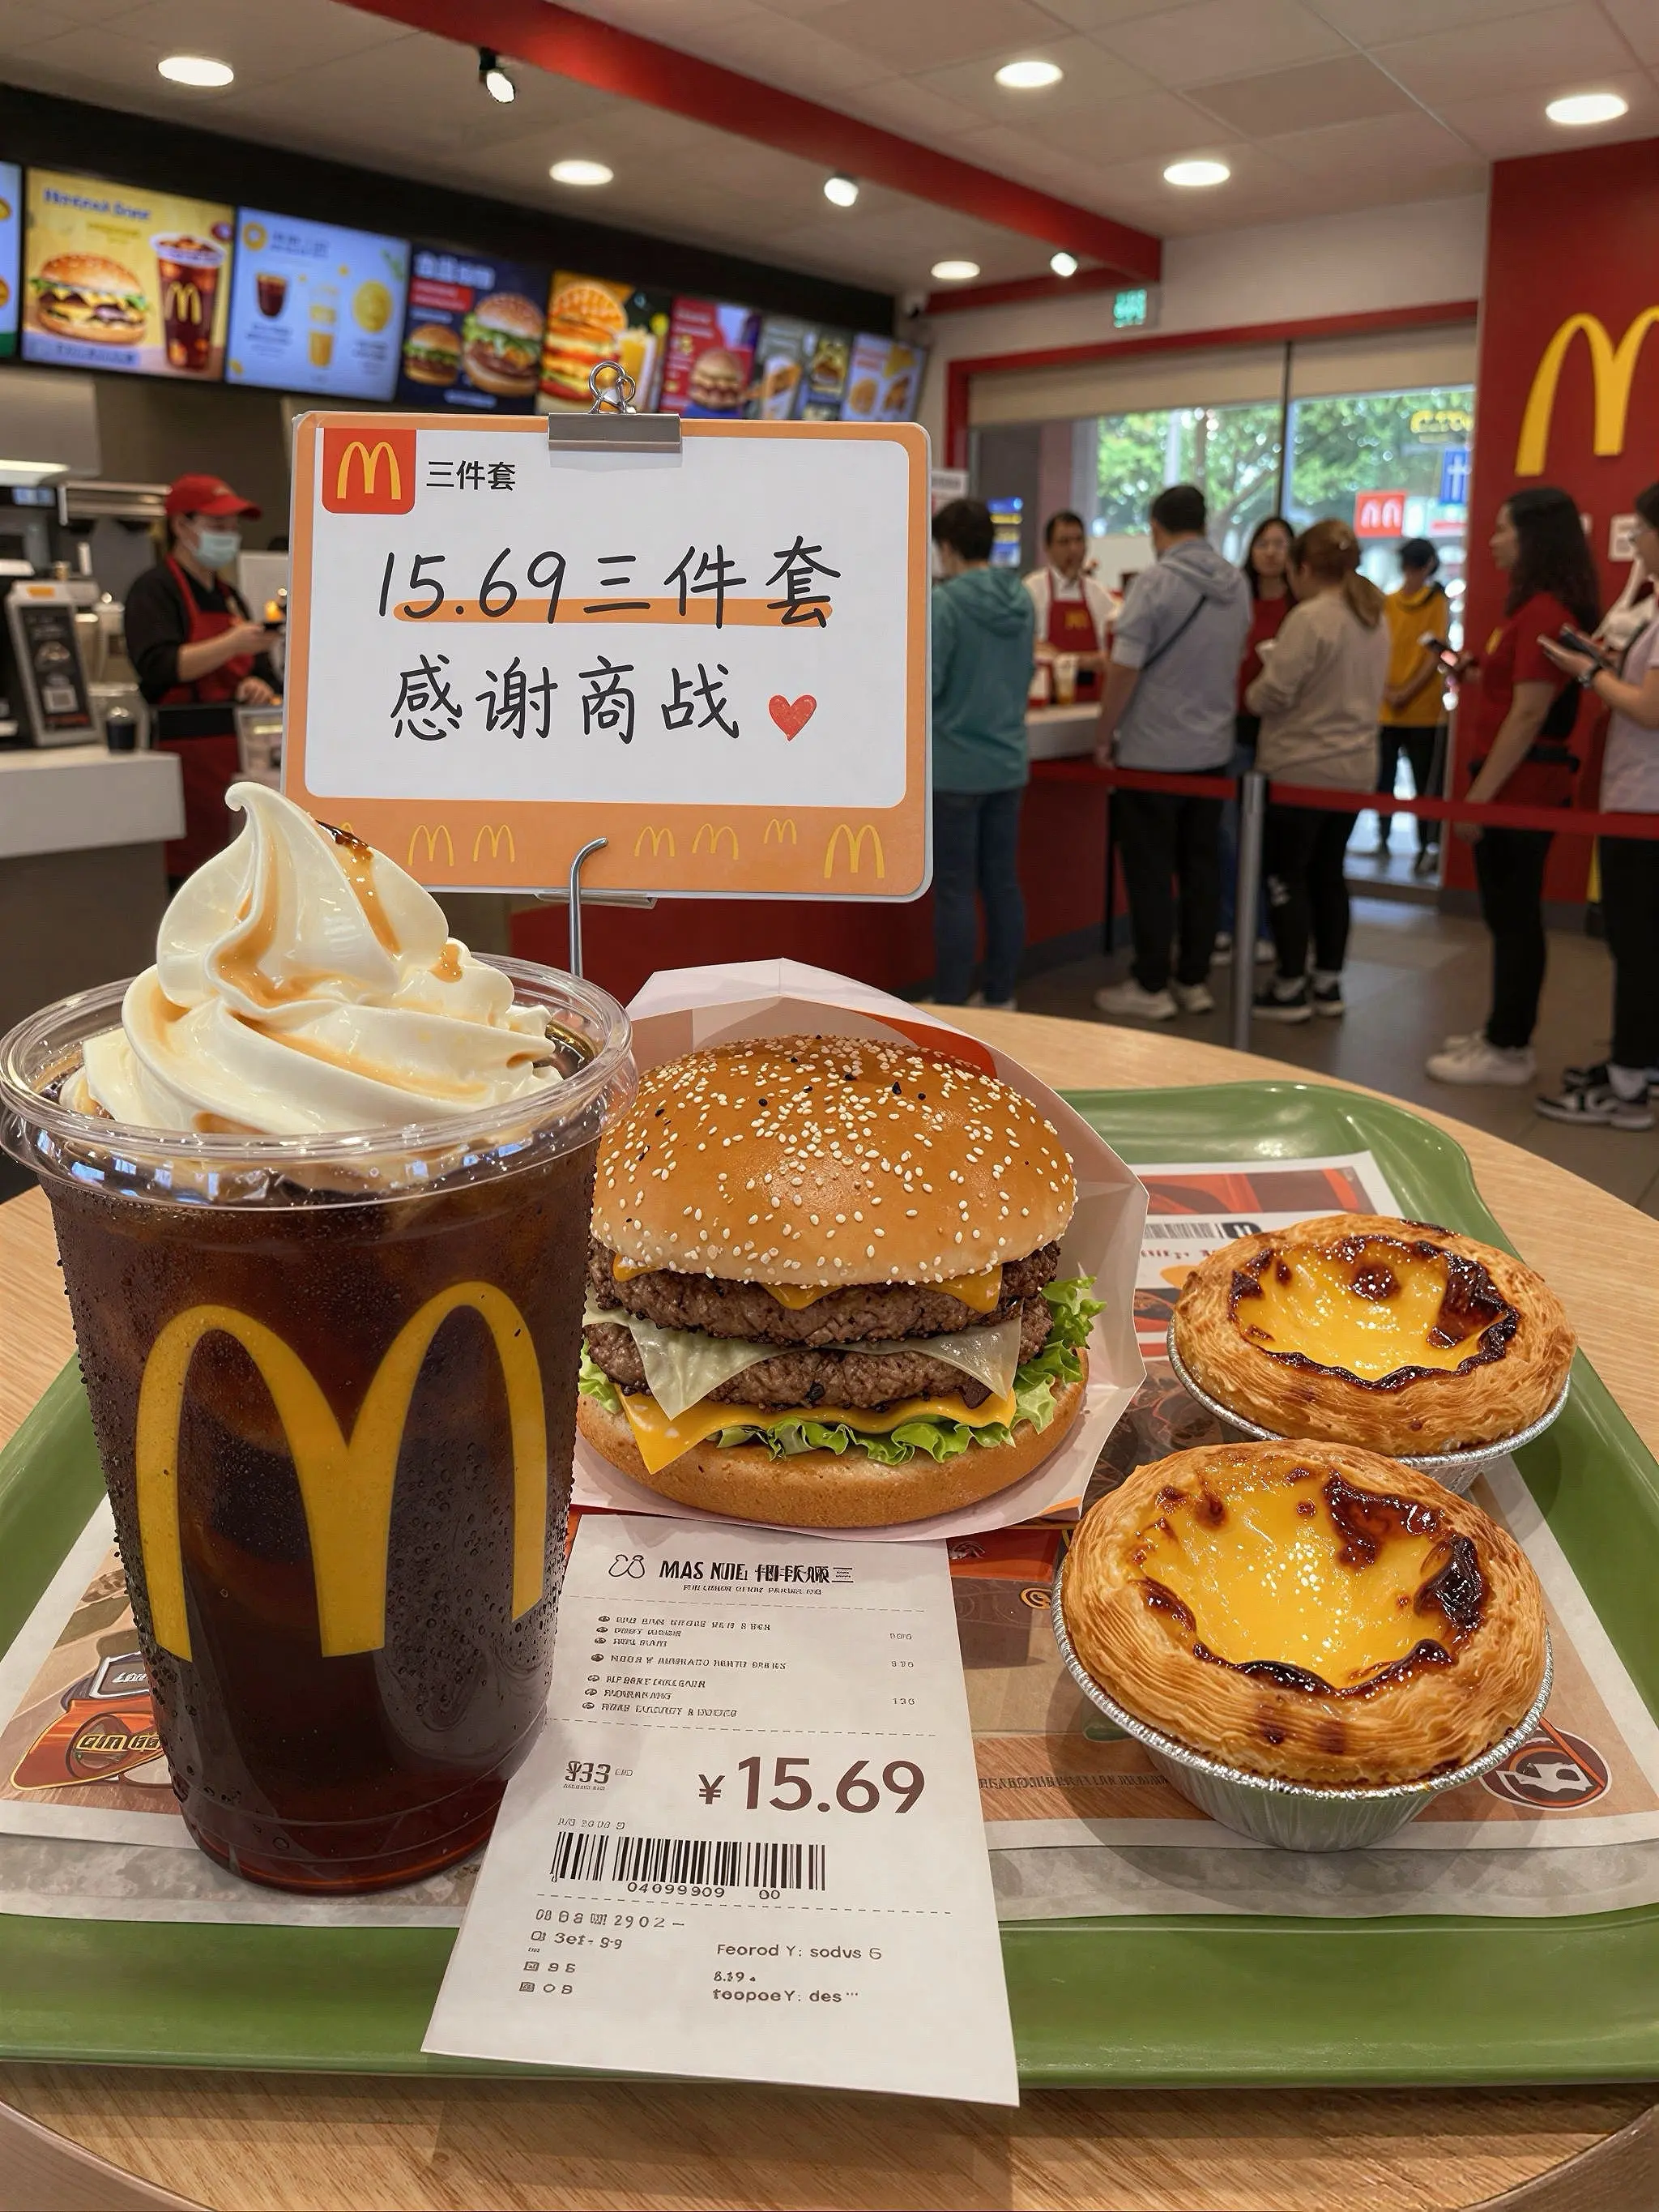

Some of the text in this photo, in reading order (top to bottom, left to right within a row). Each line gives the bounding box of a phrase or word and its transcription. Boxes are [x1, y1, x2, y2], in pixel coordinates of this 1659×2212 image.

[426, 459, 516, 492] 三件套
[390, 654, 740, 745] 感谢商战
[659, 1560, 704, 1580] MAS
[716, 1944, 779, 1957] Feorod
